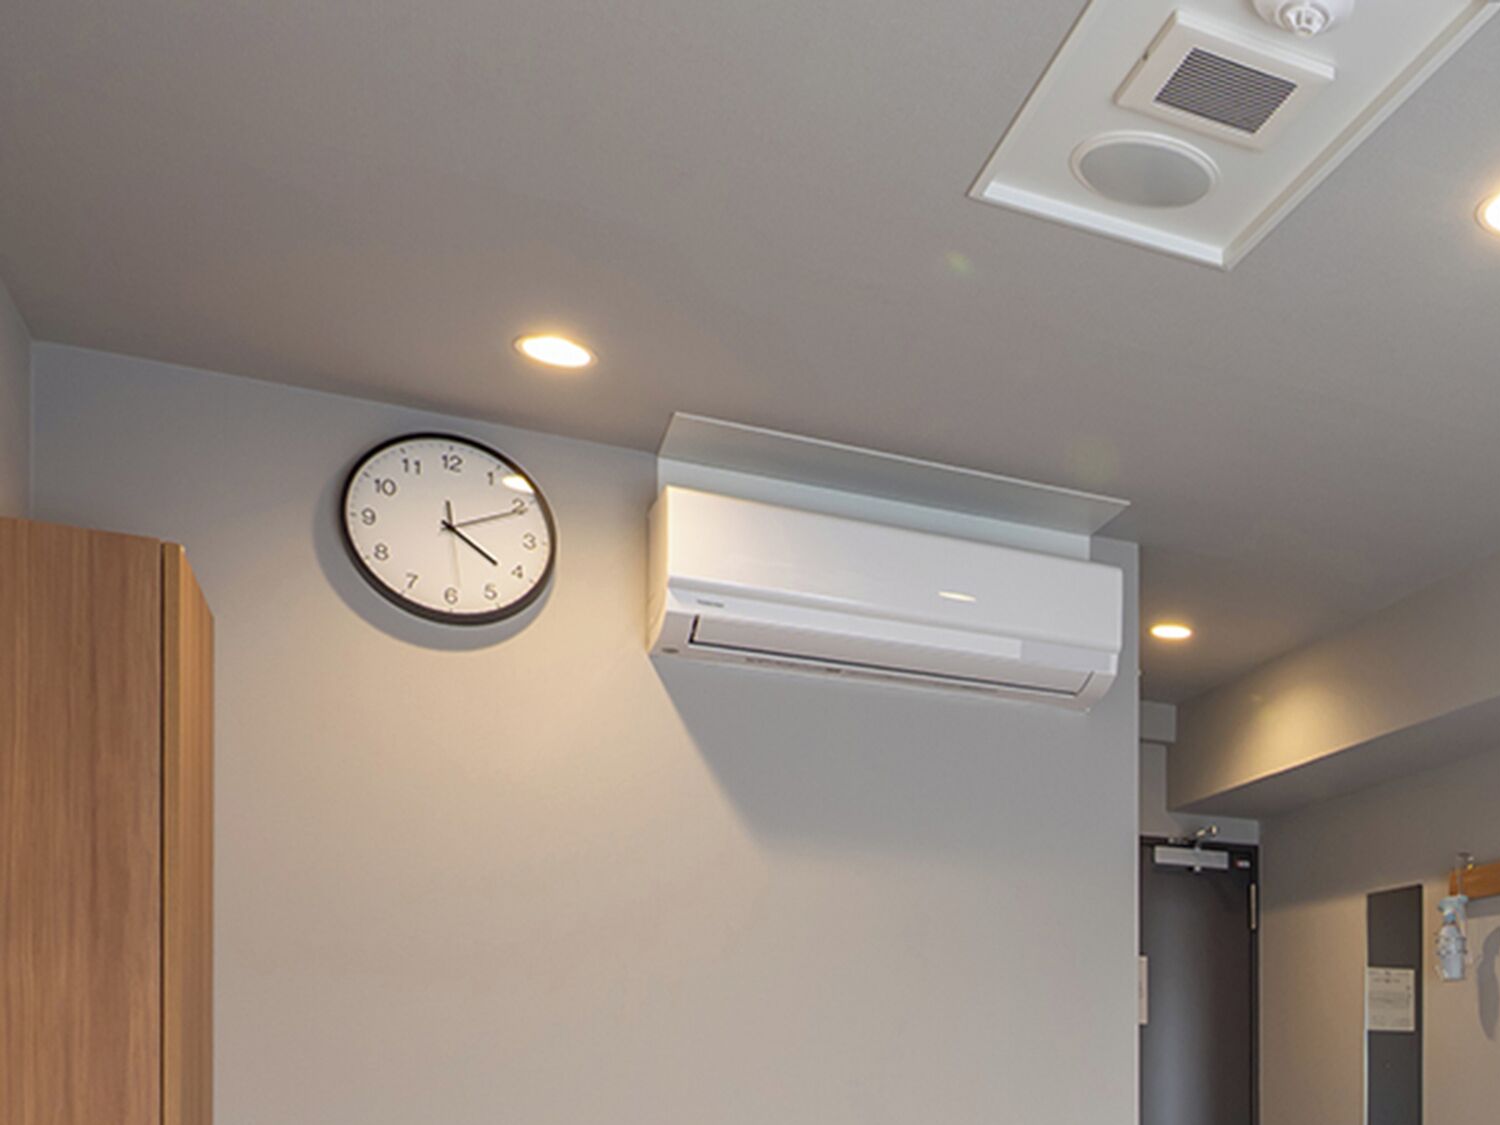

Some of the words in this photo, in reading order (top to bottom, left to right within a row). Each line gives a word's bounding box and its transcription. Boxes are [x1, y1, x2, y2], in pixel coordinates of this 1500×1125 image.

[402, 457, 422, 475] 11
[441, 453, 464, 473] 12
[374, 478, 397, 497] 10
[486, 471, 495, 487] 1
[511, 497, 528, 516] 2
[361, 508, 376, 525] 9
[522, 532, 537, 551] 3
[374, 543, 390, 562] 8
[511, 564, 525, 580] 4
[405, 573, 420, 590] 7
[444, 587, 459, 605] 6
[484, 583, 499, 601] 5
